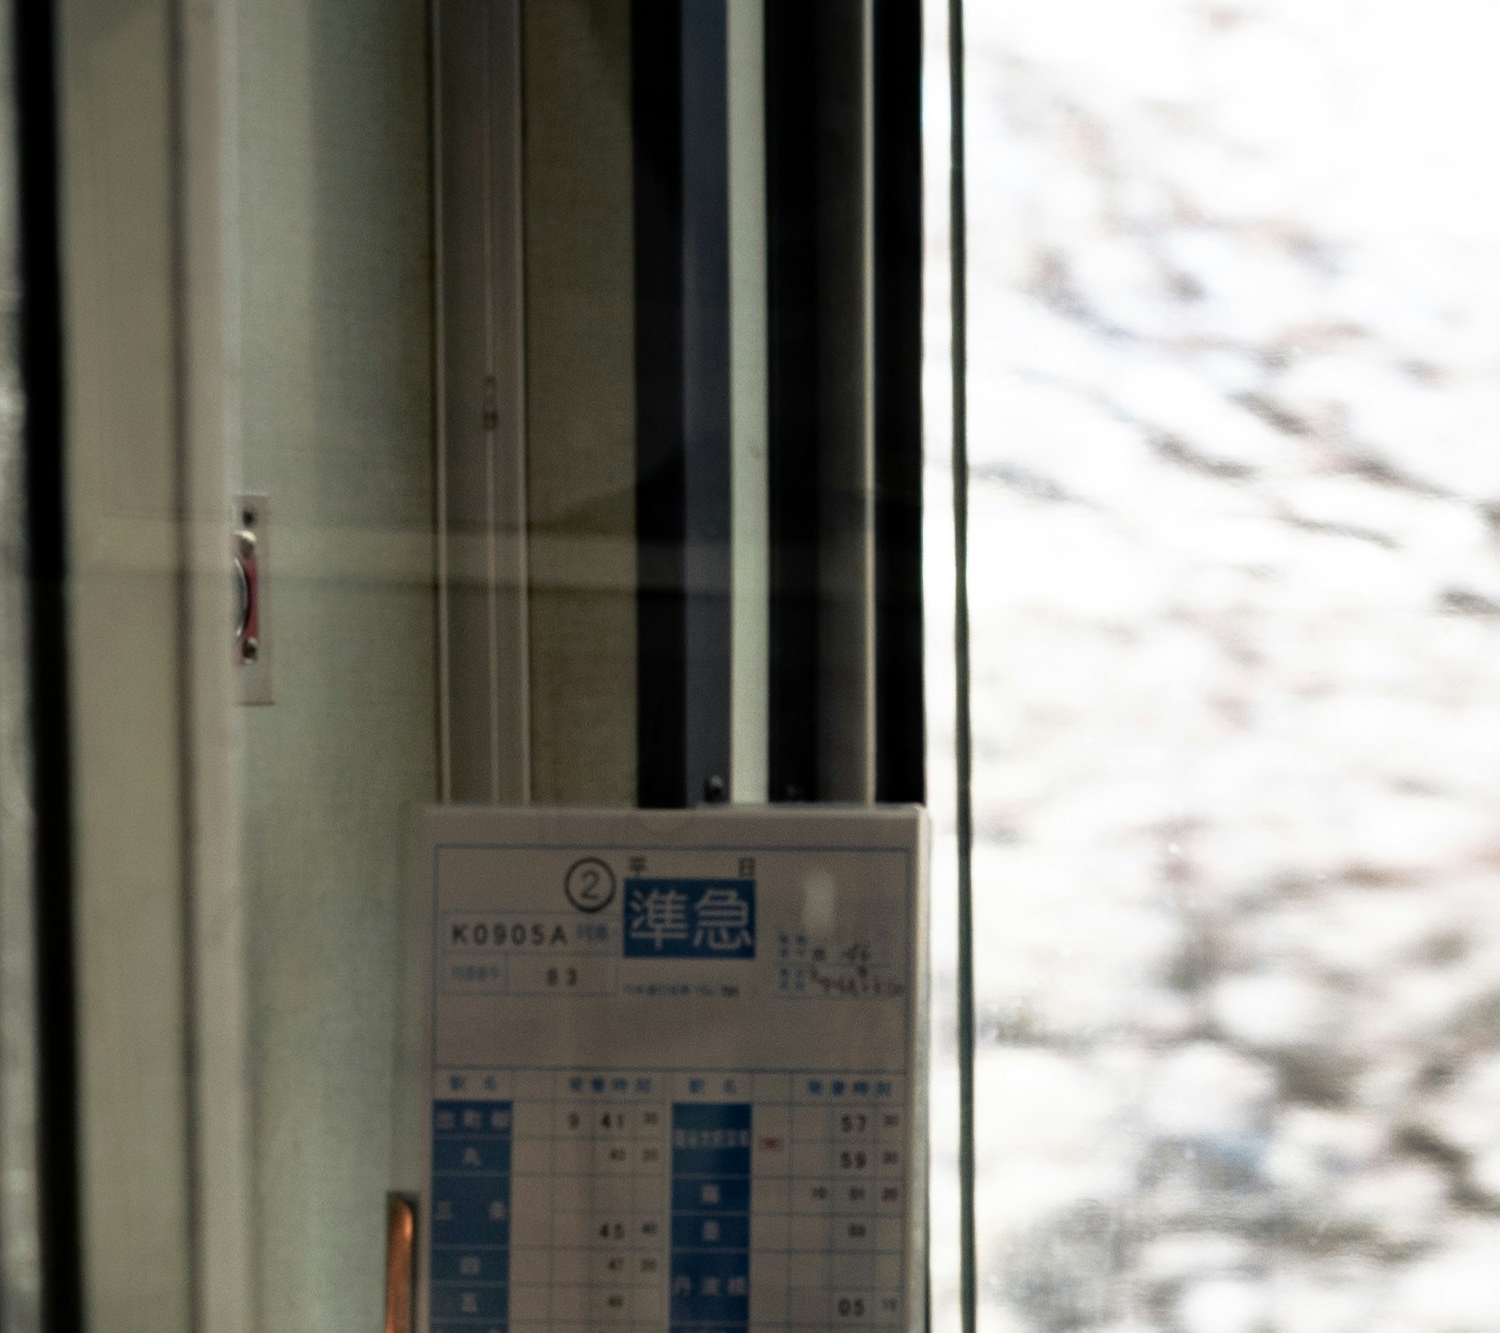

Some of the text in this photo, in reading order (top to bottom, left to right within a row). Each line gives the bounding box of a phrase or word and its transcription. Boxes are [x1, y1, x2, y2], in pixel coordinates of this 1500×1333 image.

[629, 888, 753, 951] 準急
[451, 922, 568, 946] K0905A
[841, 1115, 868, 1133] 57
[838, 1299, 865, 1317] 05
